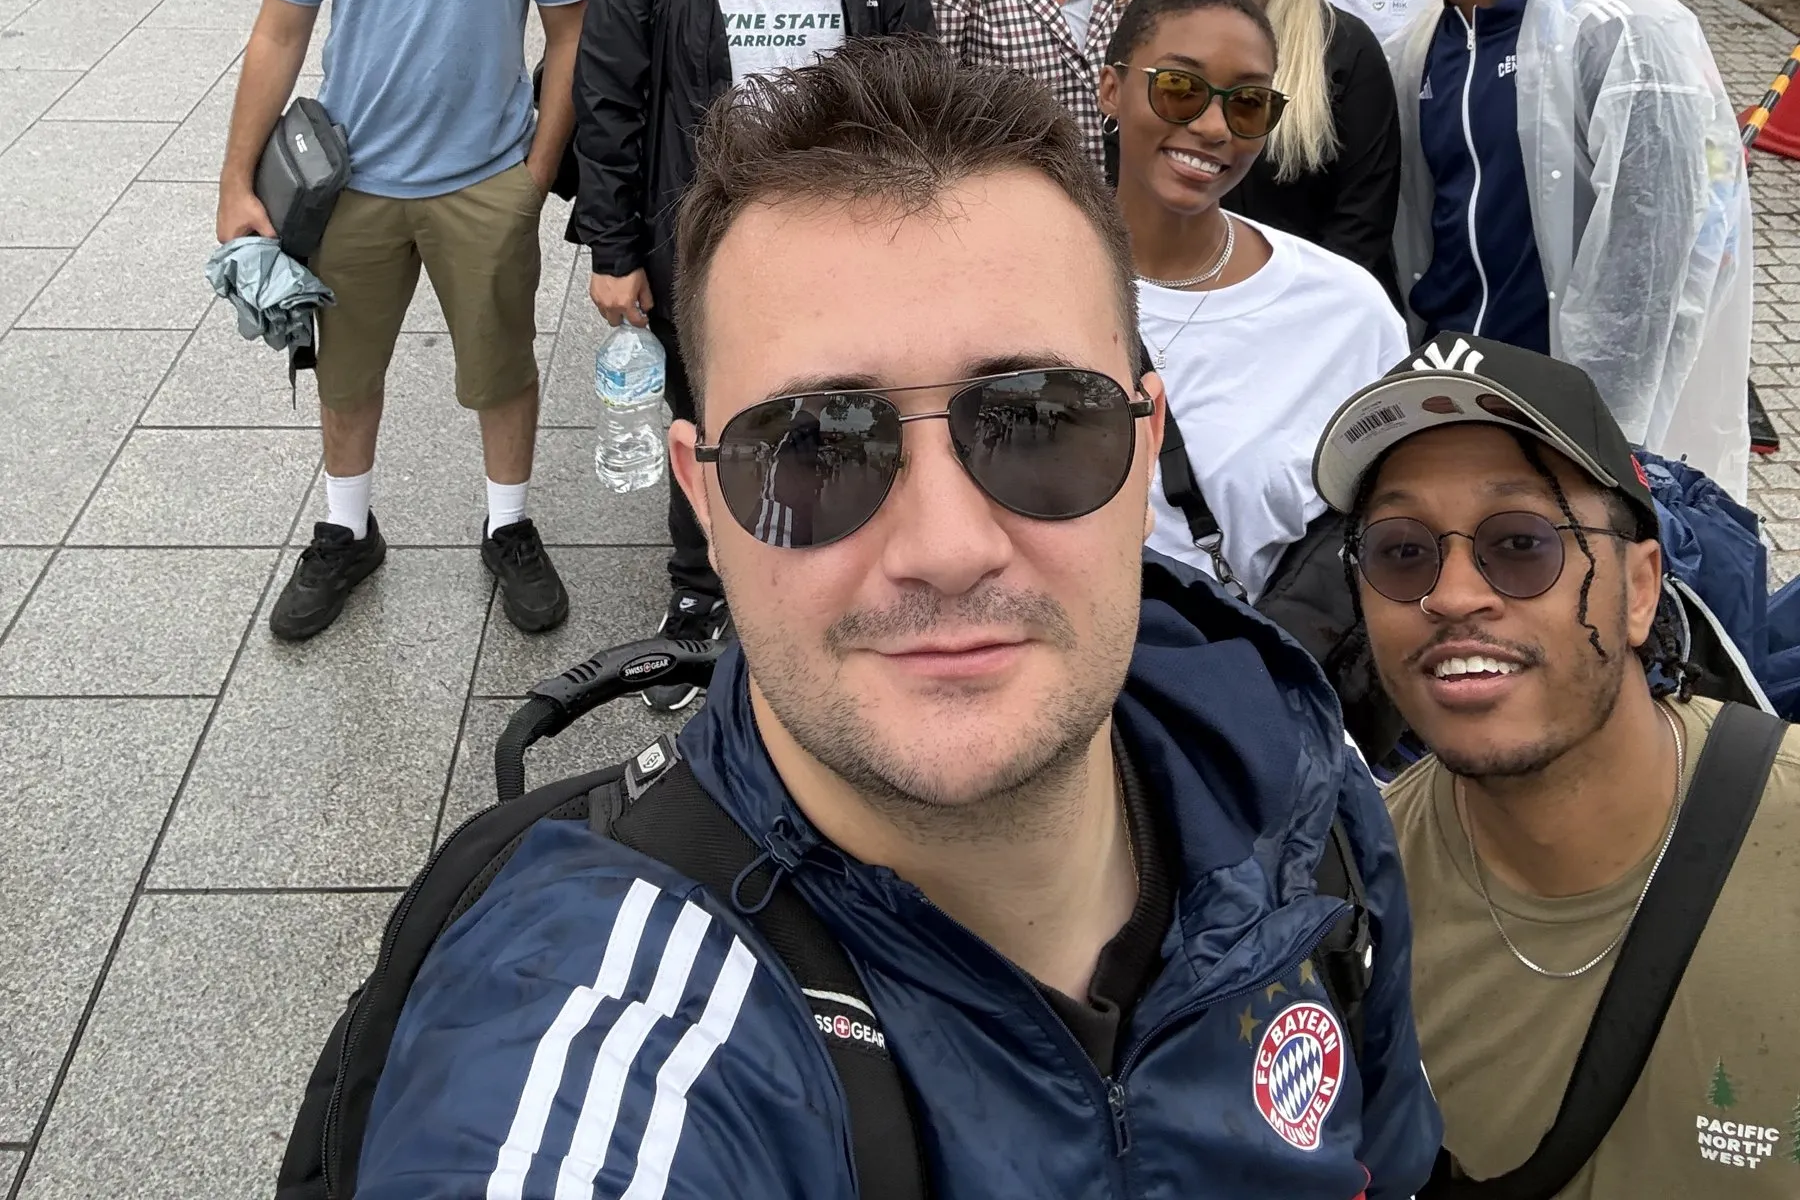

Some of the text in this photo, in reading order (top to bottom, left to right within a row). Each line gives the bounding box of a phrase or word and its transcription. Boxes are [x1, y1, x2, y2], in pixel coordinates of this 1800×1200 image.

[773, 12, 841, 29] STATE
[624, 658, 669, 677] SWISS GEAR
[851, 1021, 886, 1050] GEAR
[1257, 1009, 1338, 1085] FC BAYERN
[1696, 1115, 1780, 1142] PACIFIC
[1698, 1131, 1773, 1157] NORTH
[1700, 1146, 1761, 1169] WEST
